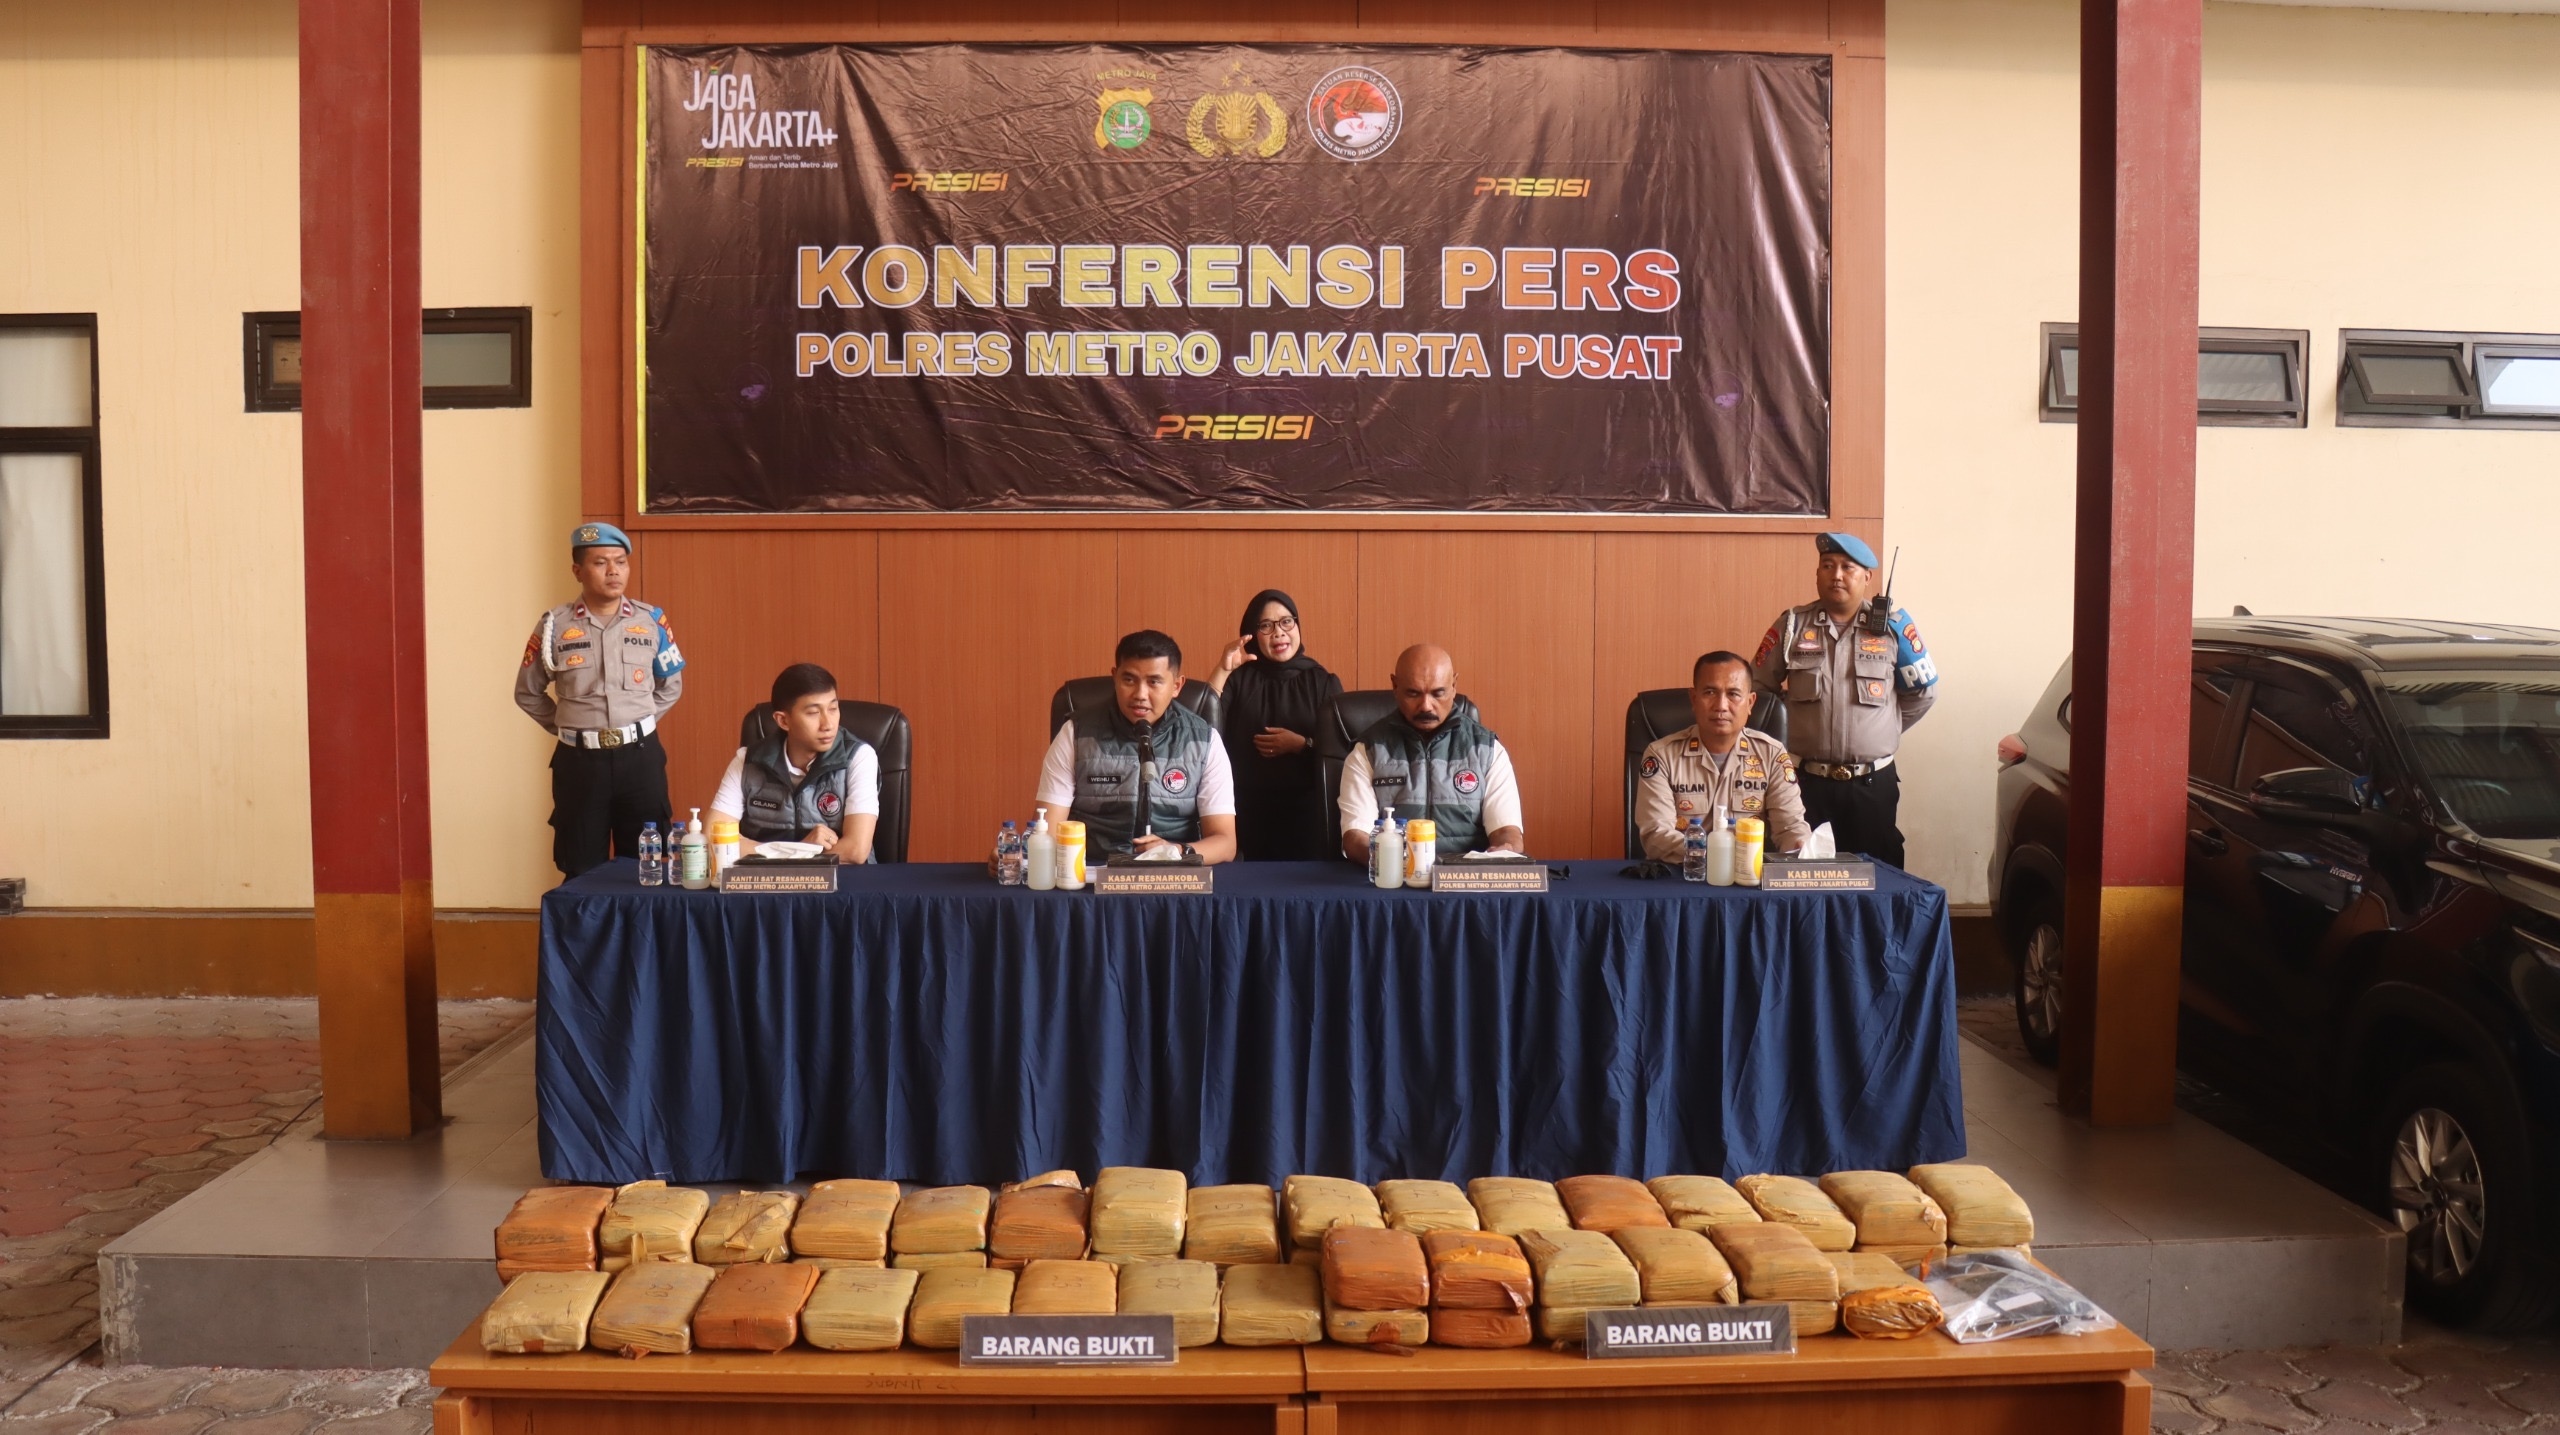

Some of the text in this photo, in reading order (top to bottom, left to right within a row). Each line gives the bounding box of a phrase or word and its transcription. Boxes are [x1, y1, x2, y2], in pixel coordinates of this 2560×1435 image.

[1096, 70, 1158, 81] METRO JAYA
[683, 70, 756, 111] JAGA
[1317, 71, 1397, 117] SATUAN RESERSE NARKOBA
[1314, 120, 1396, 157] POLRES METRO JAKARTA PUSAT
[685, 157, 744, 167] PRESISI
[821, 162, 838, 170] Jaya
[890, 172, 1008, 192] PRESISI
[1474, 177, 1591, 198] PRESISI
[797, 244, 1682, 312] KONFERENSI PERS
[796, 331, 1682, 379] POLRES METRO JAKARTA PUSAT
[1154, 414, 1314, 440] PRESISI
[624, 637, 652, 647] POLRI
[1859, 653, 1888, 661] POLRI
[1672, 783, 1705, 793] USLAN
[752, 800, 777, 809] GILANG
[1138, 874, 1198, 882] RESNARKOBA
[1788, 870, 1850, 879] KASI HUMAS
[1607, 1320, 1772, 1345] BARANG BUKTI
[982, 1336, 1154, 1356] BARANG BUKTI
